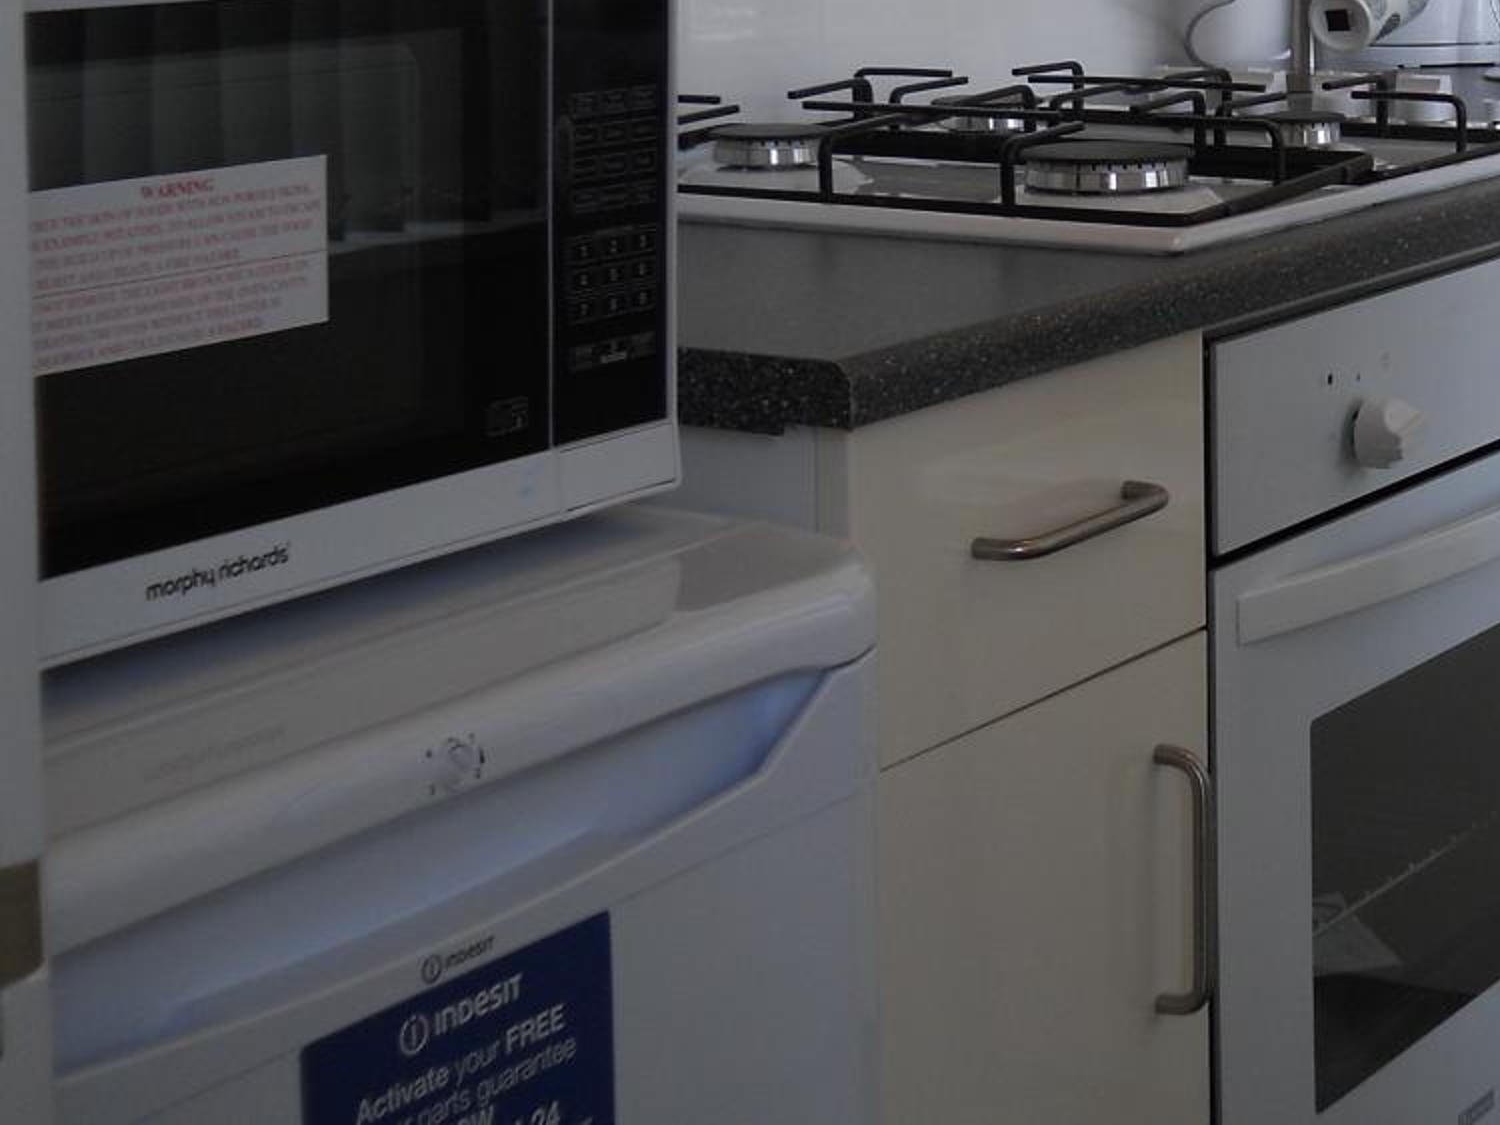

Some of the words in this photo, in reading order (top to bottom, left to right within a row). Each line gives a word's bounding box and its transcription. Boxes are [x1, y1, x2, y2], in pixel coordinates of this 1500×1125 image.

[140, 177, 215, 200] WARNING
[146, 567, 215, 601] morphy
[219, 545, 290, 580] richards
[433, 971, 523, 1037] INDESIT
[355, 1066, 450, 1125] Activate
[454, 1037, 501, 1087] your
[504, 1003, 567, 1056] FREE
[476, 1035, 577, 1105] guarantee
